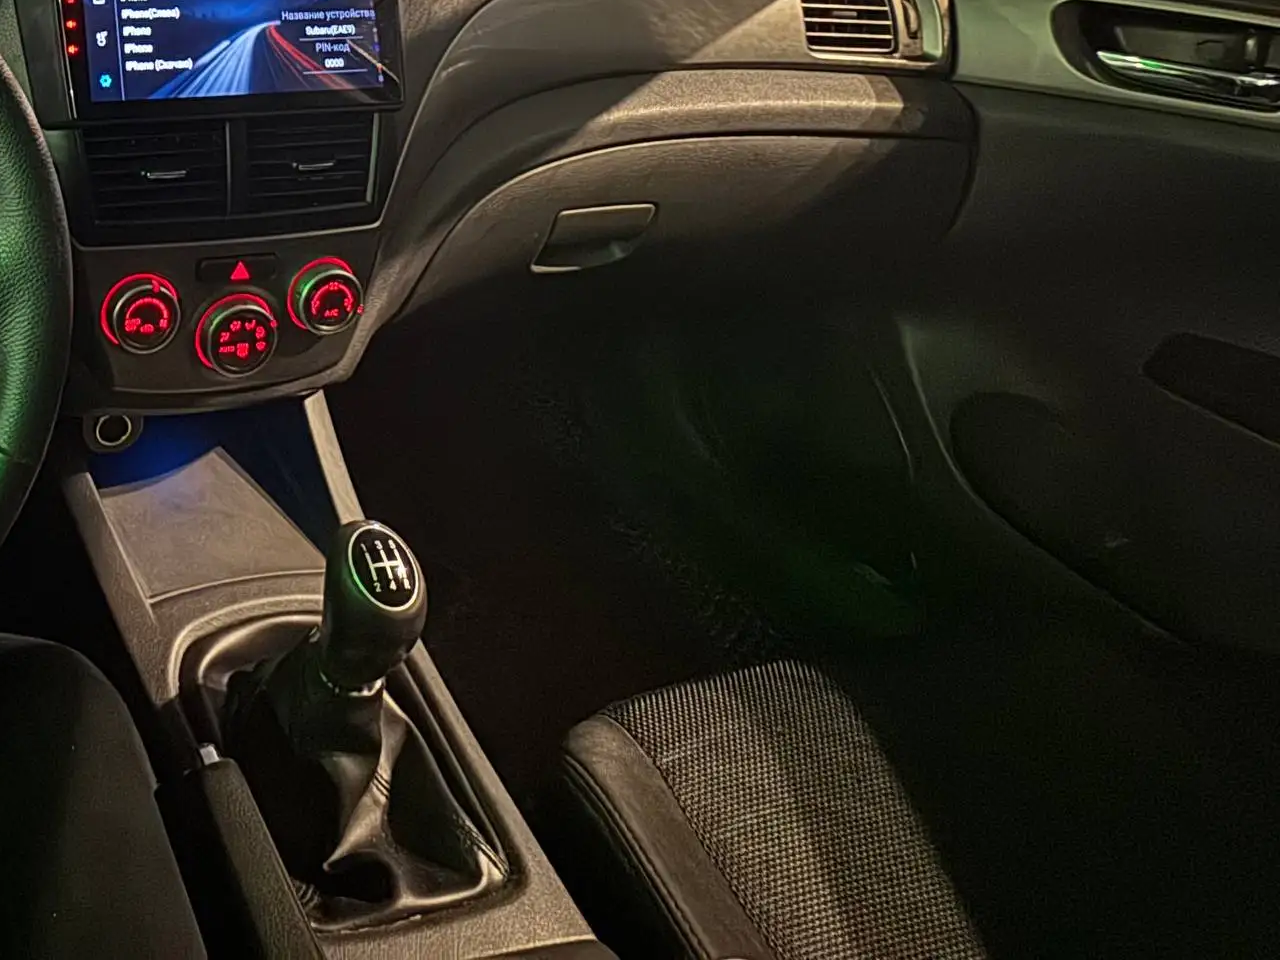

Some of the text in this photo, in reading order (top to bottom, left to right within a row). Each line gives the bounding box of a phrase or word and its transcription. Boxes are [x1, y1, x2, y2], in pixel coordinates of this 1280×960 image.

[281, 8, 376, 22] Название устройства
[122, 25, 152, 36] iPhone
[124, 43, 154, 54] iPhone
[315, 42, 351, 53] PIN-код
[125, 61, 155, 71] iPhone
[324, 58, 345, 68] 0000
[324, 309, 339, 317] A/C
[374, 540, 383, 550] 3
[388, 539, 395, 549] 5
[373, 583, 382, 592] 2
[389, 579, 397, 591] 4
[403, 578, 411, 589] R
